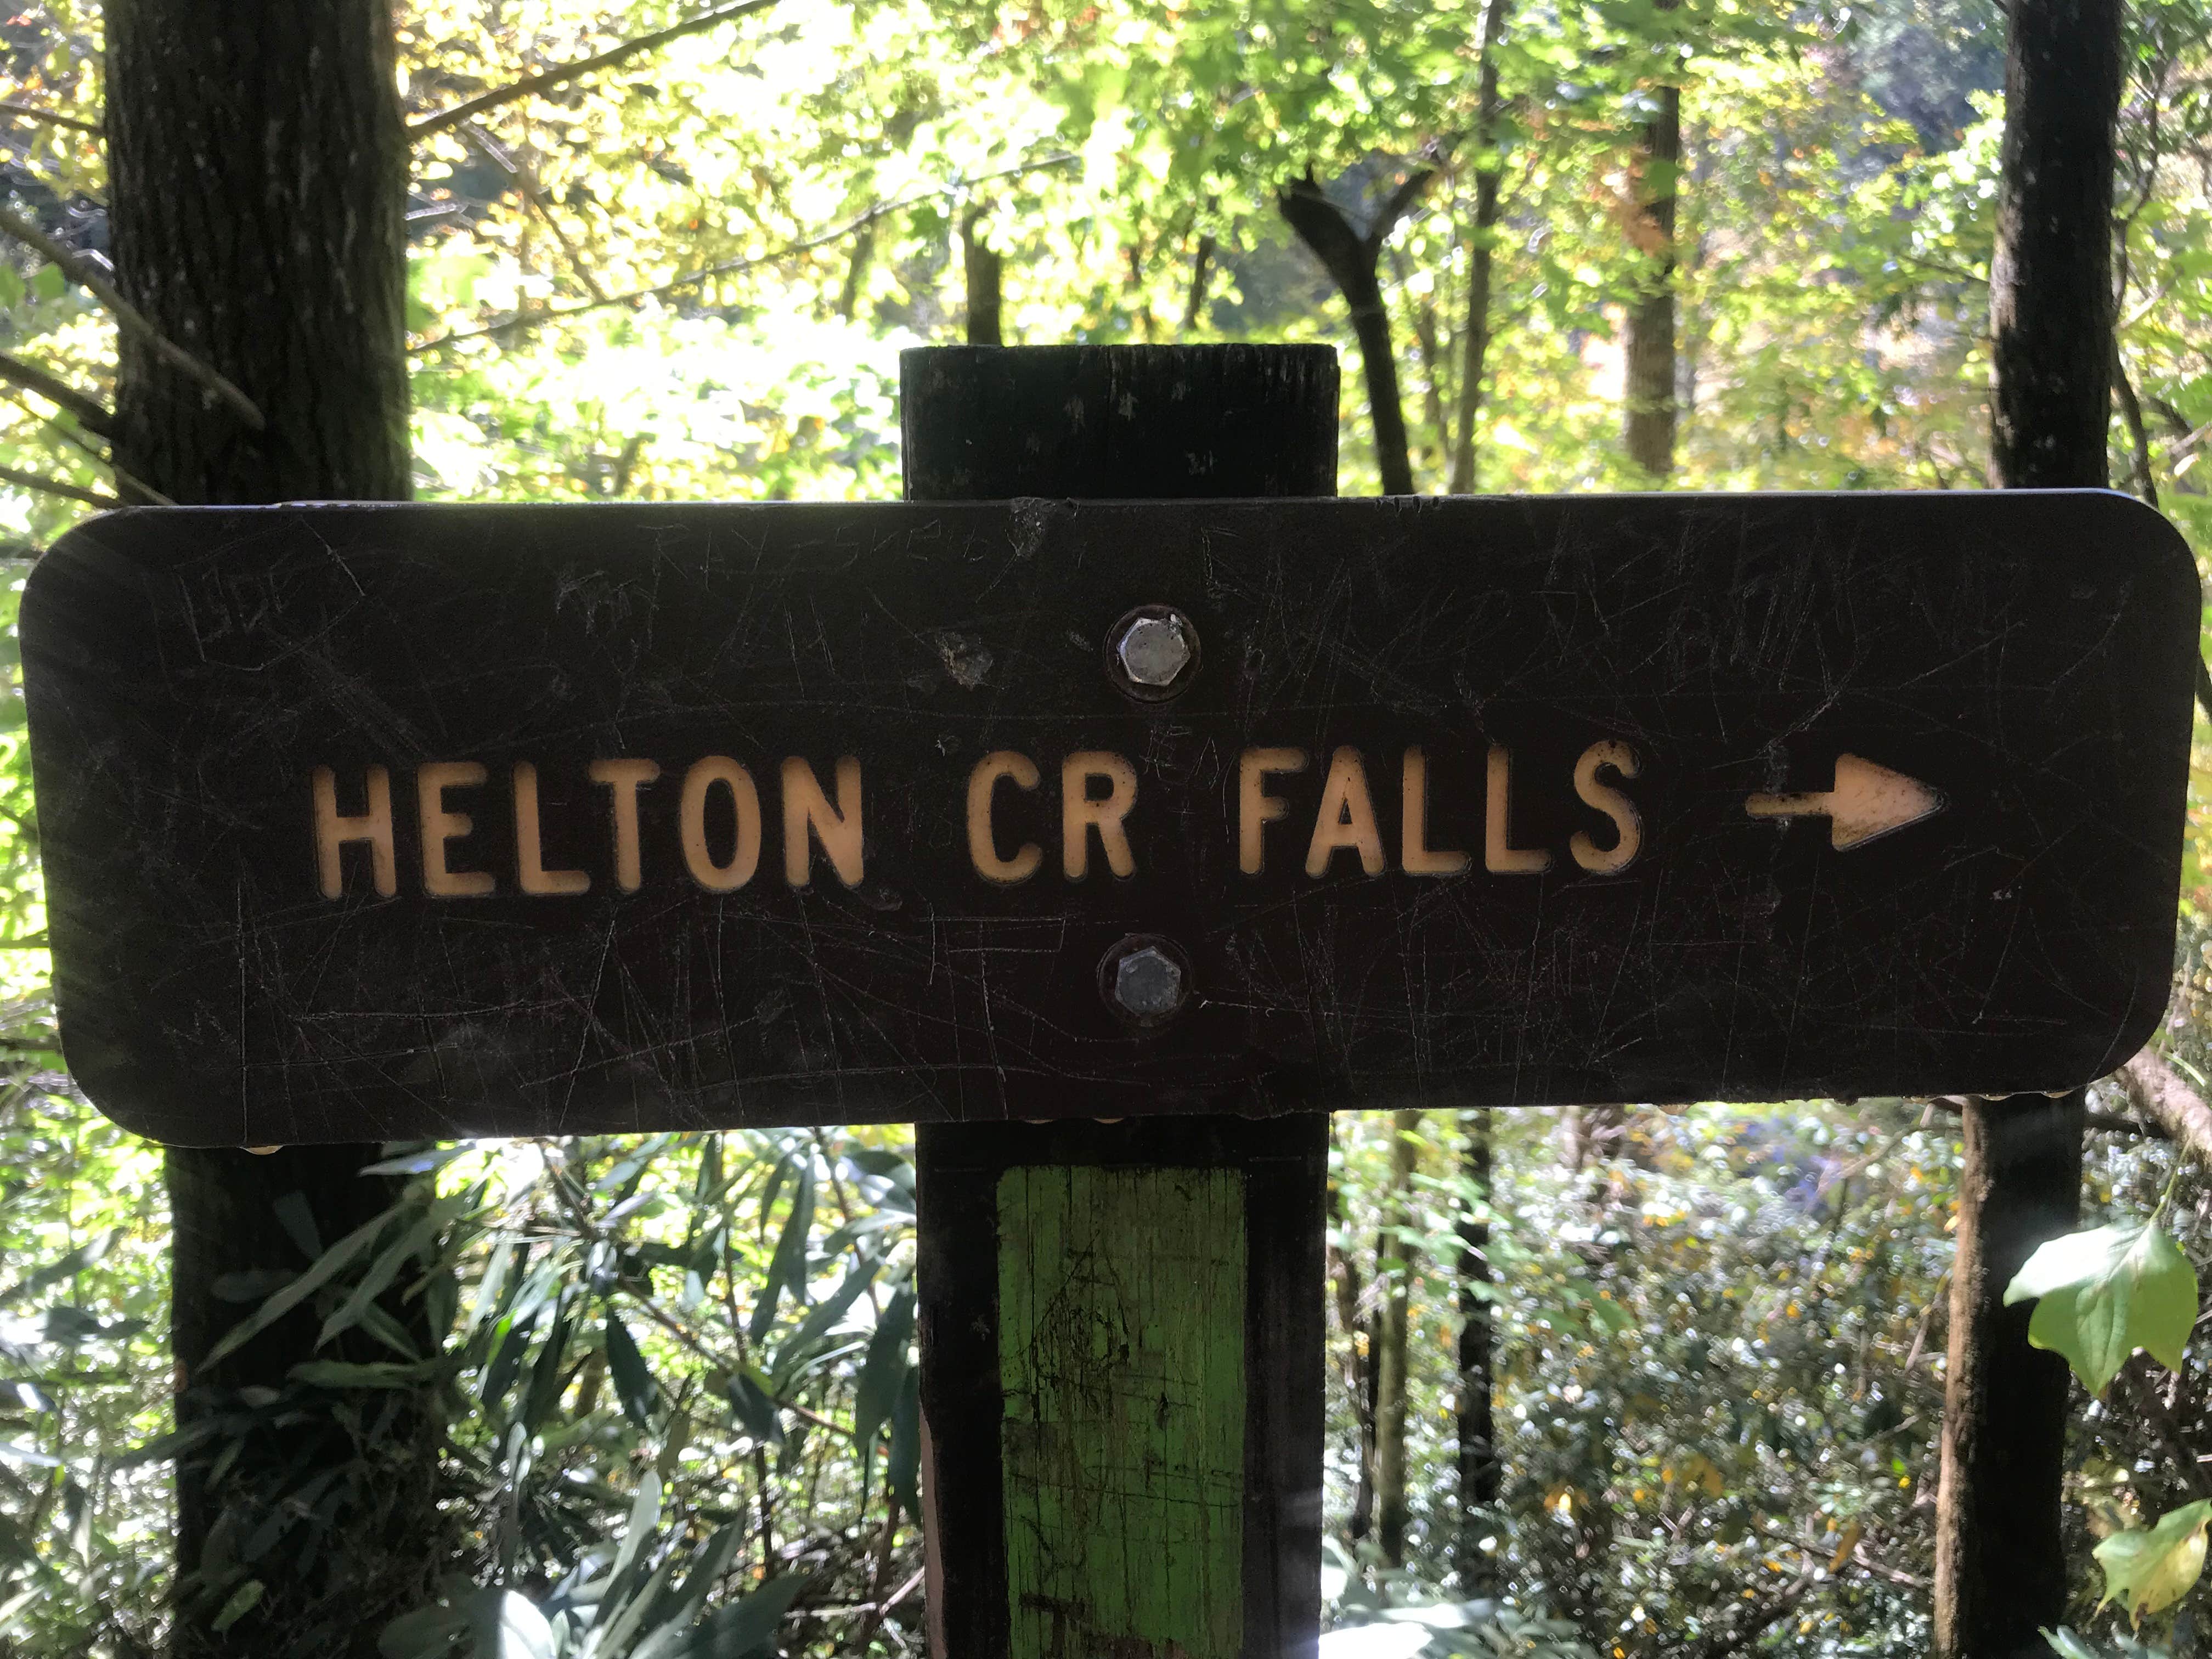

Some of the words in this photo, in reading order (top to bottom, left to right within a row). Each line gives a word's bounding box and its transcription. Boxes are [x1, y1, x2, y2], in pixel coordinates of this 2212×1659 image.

[312, 757, 865, 900] HELTON
[966, 749, 1138, 882] CR
[1238, 741, 1639, 878] FALLS
